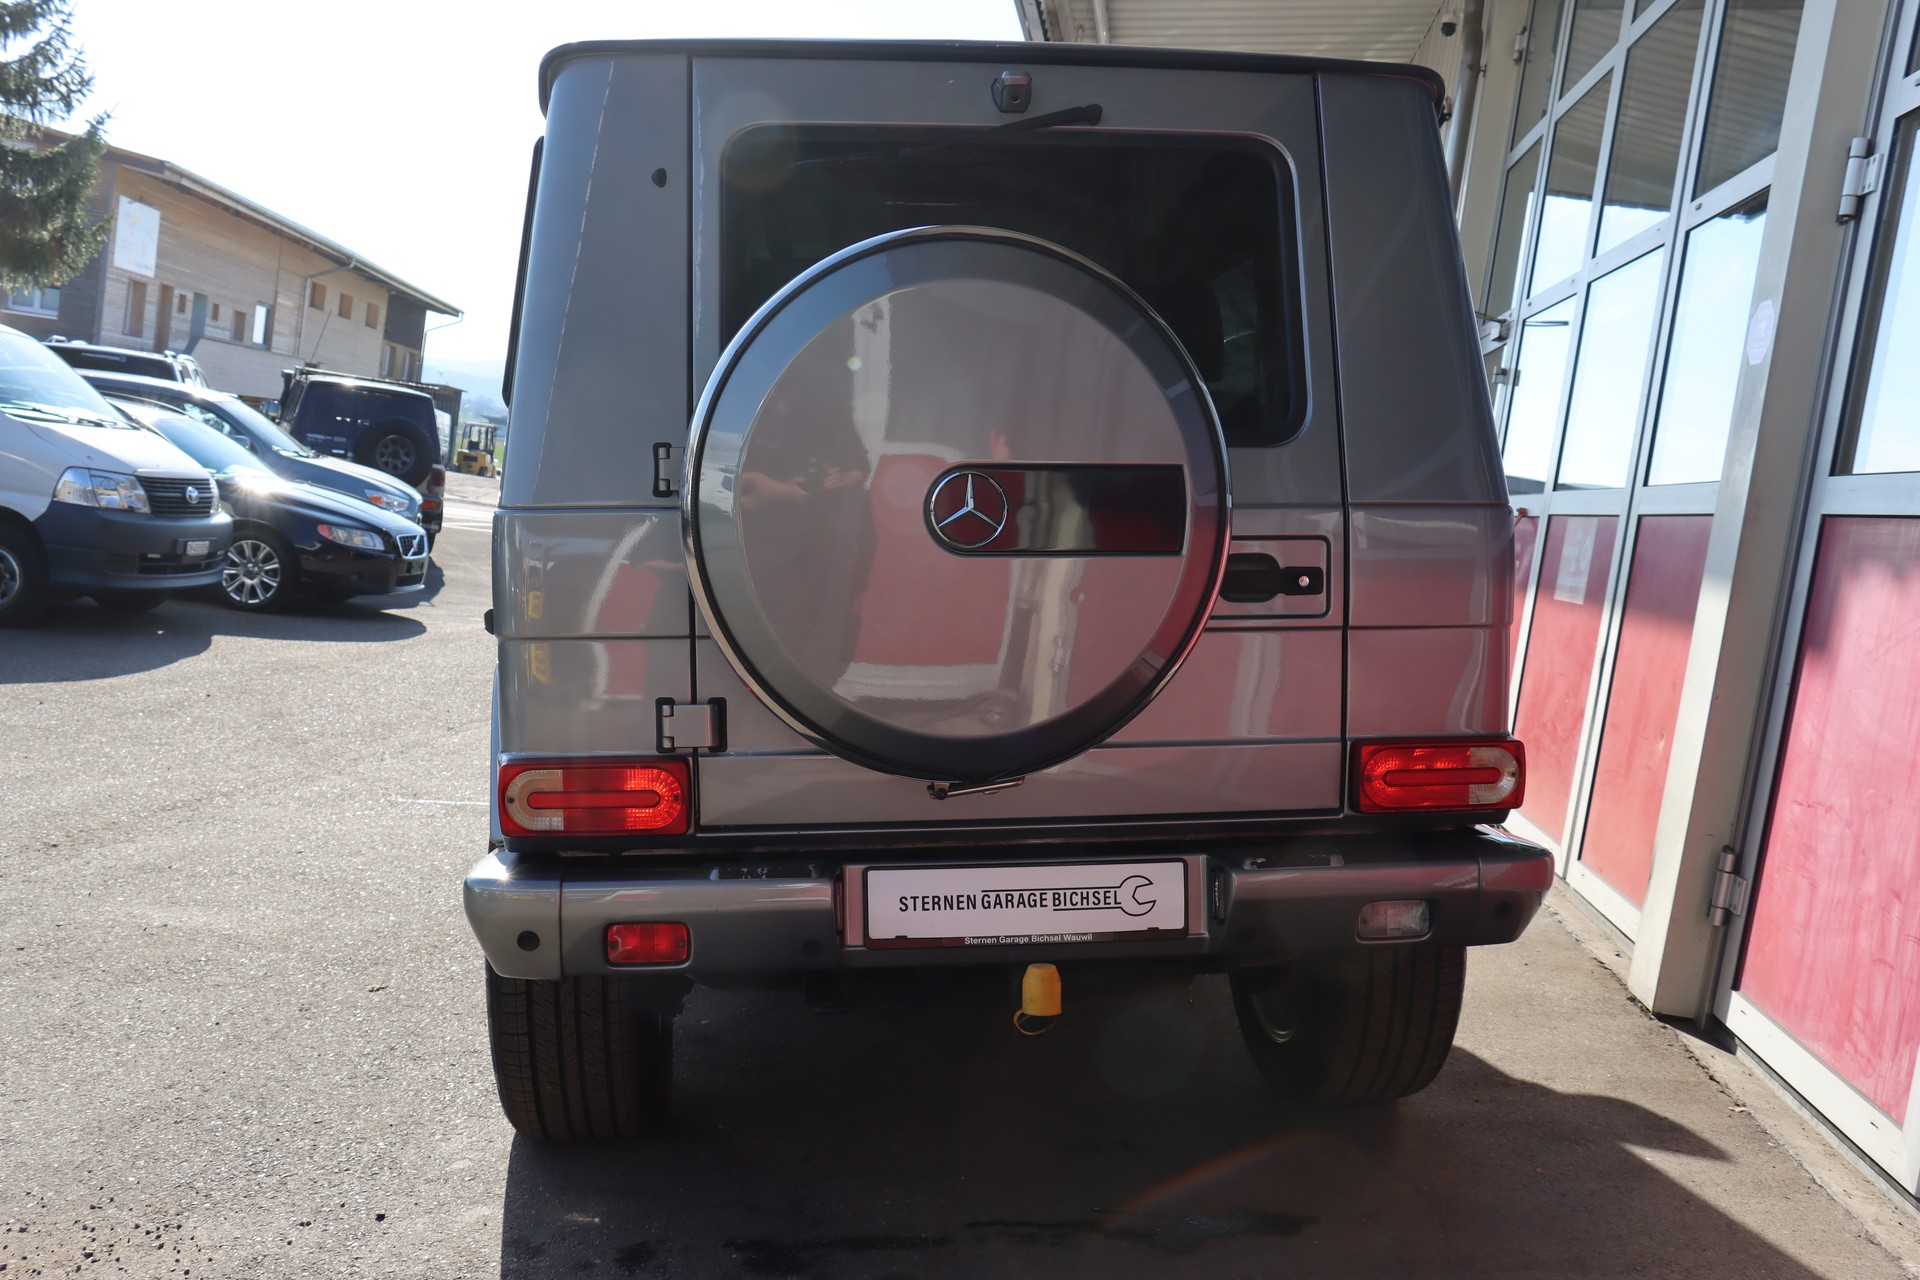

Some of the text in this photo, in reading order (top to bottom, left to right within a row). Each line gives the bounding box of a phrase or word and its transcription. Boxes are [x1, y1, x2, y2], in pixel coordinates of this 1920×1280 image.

[898, 890, 1122, 912] STERNEN GARAGE BICHSEL
[964, 932, 1093, 945] Sternen Garage Bichsel Wauwil
